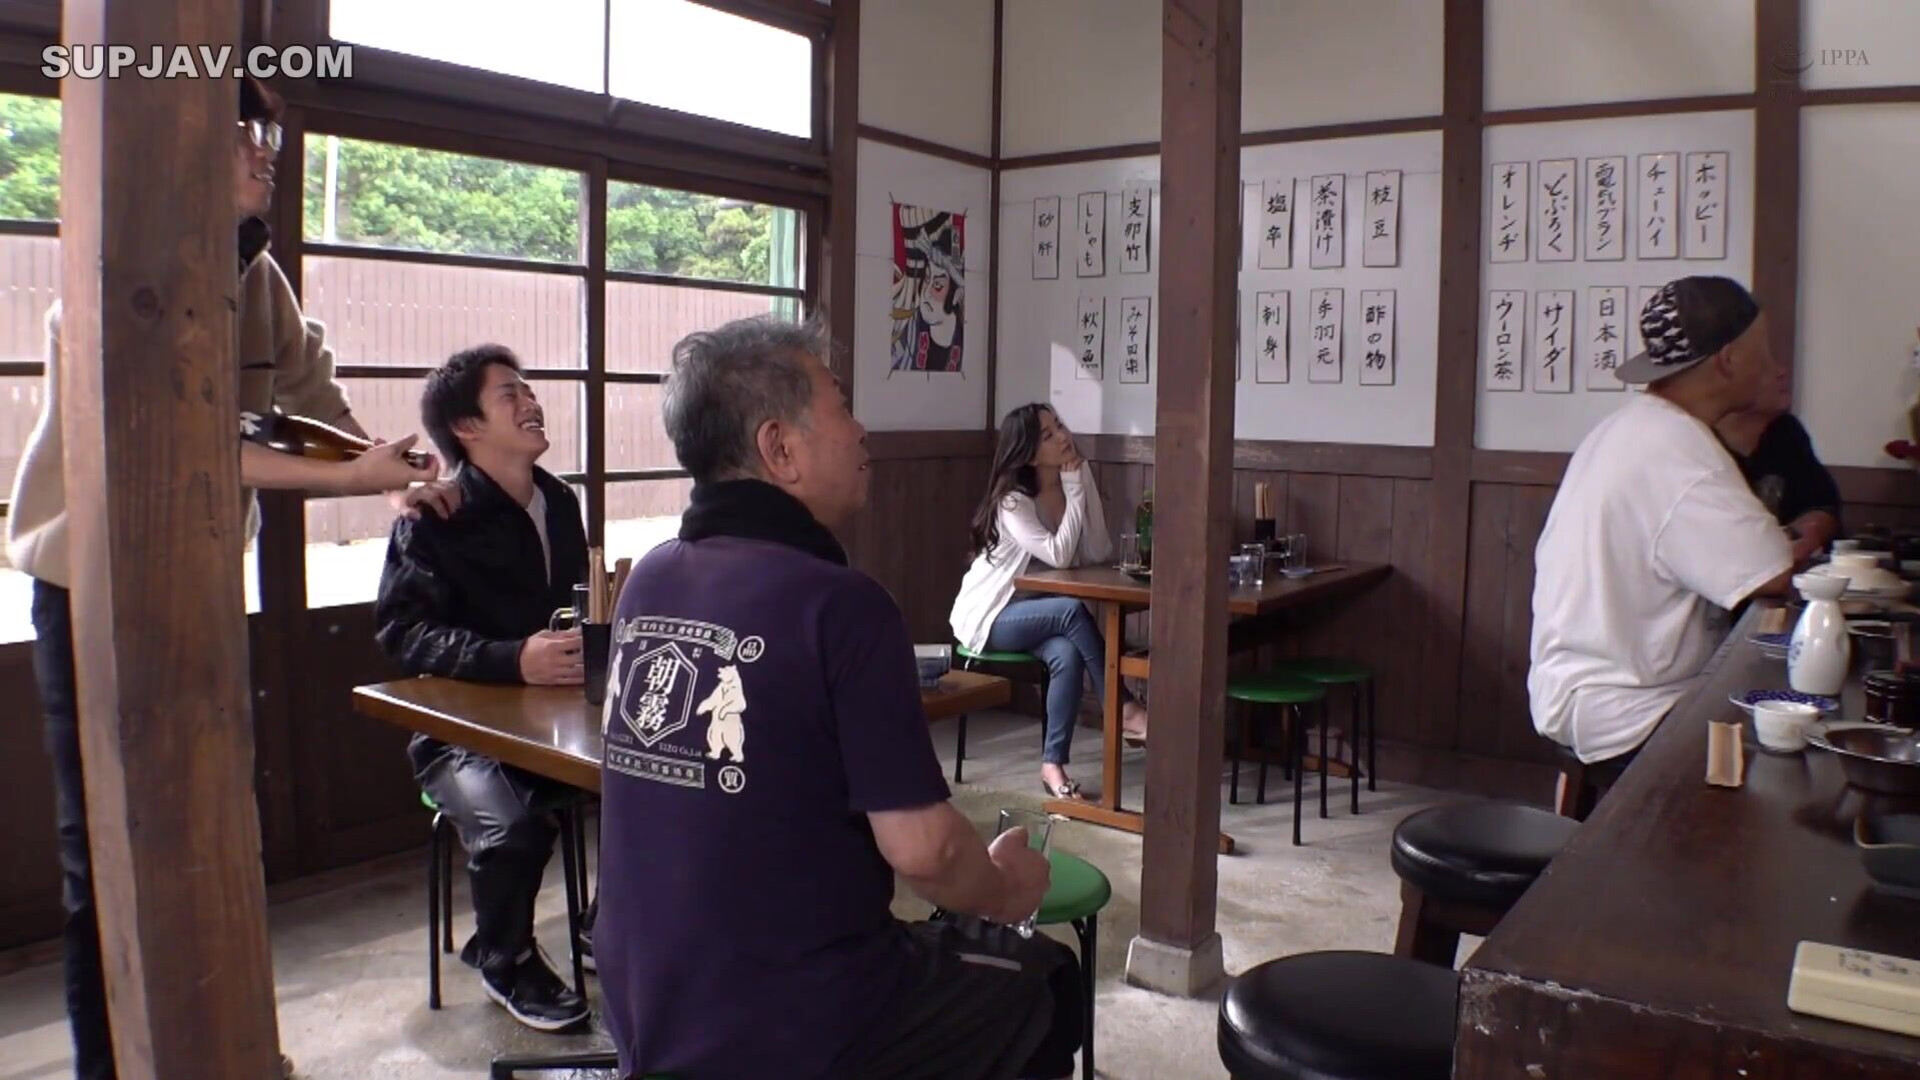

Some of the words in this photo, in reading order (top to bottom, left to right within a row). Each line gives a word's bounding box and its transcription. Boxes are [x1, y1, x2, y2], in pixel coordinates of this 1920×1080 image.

[1038, 212, 1054, 256] 砂肝
[1085, 201, 1097, 267] ししゃも
[1124, 196, 1144, 261] 支那竹
[1313, 180, 1338, 255] 茶漬け
[1371, 185, 1393, 241] 枝豆
[1544, 172, 1568, 253] どぶろく
[1647, 162, 1666, 247] チューハイ
[1080, 311, 1099, 369] 秋刀魚
[1262, 305, 1281, 361] 刺身
[1313, 298, 1335, 366] 手羽元
[1365, 304, 1387, 370] 酢の物
[1494, 298, 1514, 380] ウーロン茶
[1543, 301, 1566, 383] サイダー
[1594, 298, 1618, 370] 日本酒
